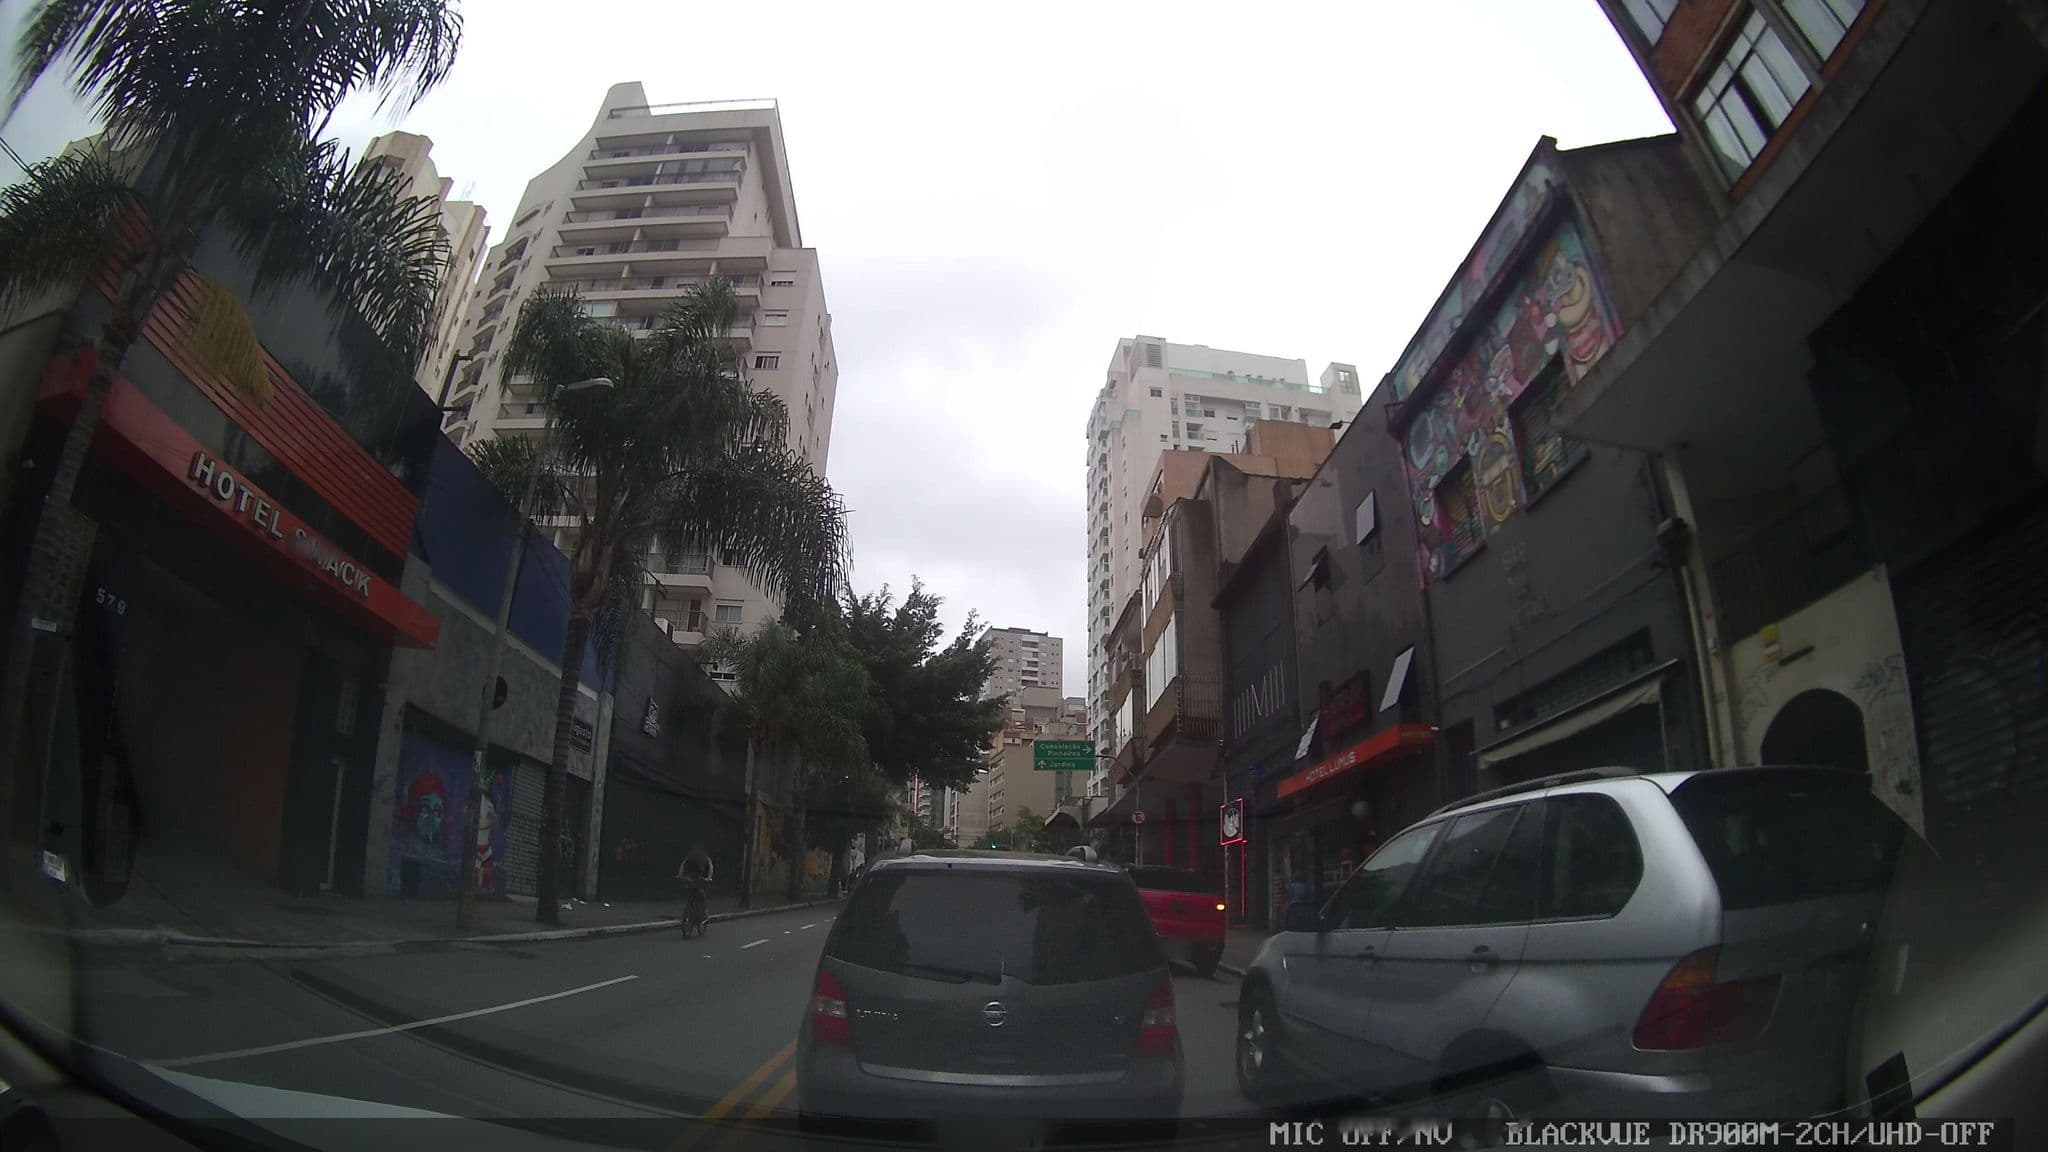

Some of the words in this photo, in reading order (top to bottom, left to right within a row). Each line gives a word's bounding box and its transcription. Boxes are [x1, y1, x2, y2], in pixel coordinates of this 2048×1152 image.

[194, 452, 284, 540] HOTEL
[96, 587, 125, 615] 579
[1040, 743, 1081, 751] Consolação
